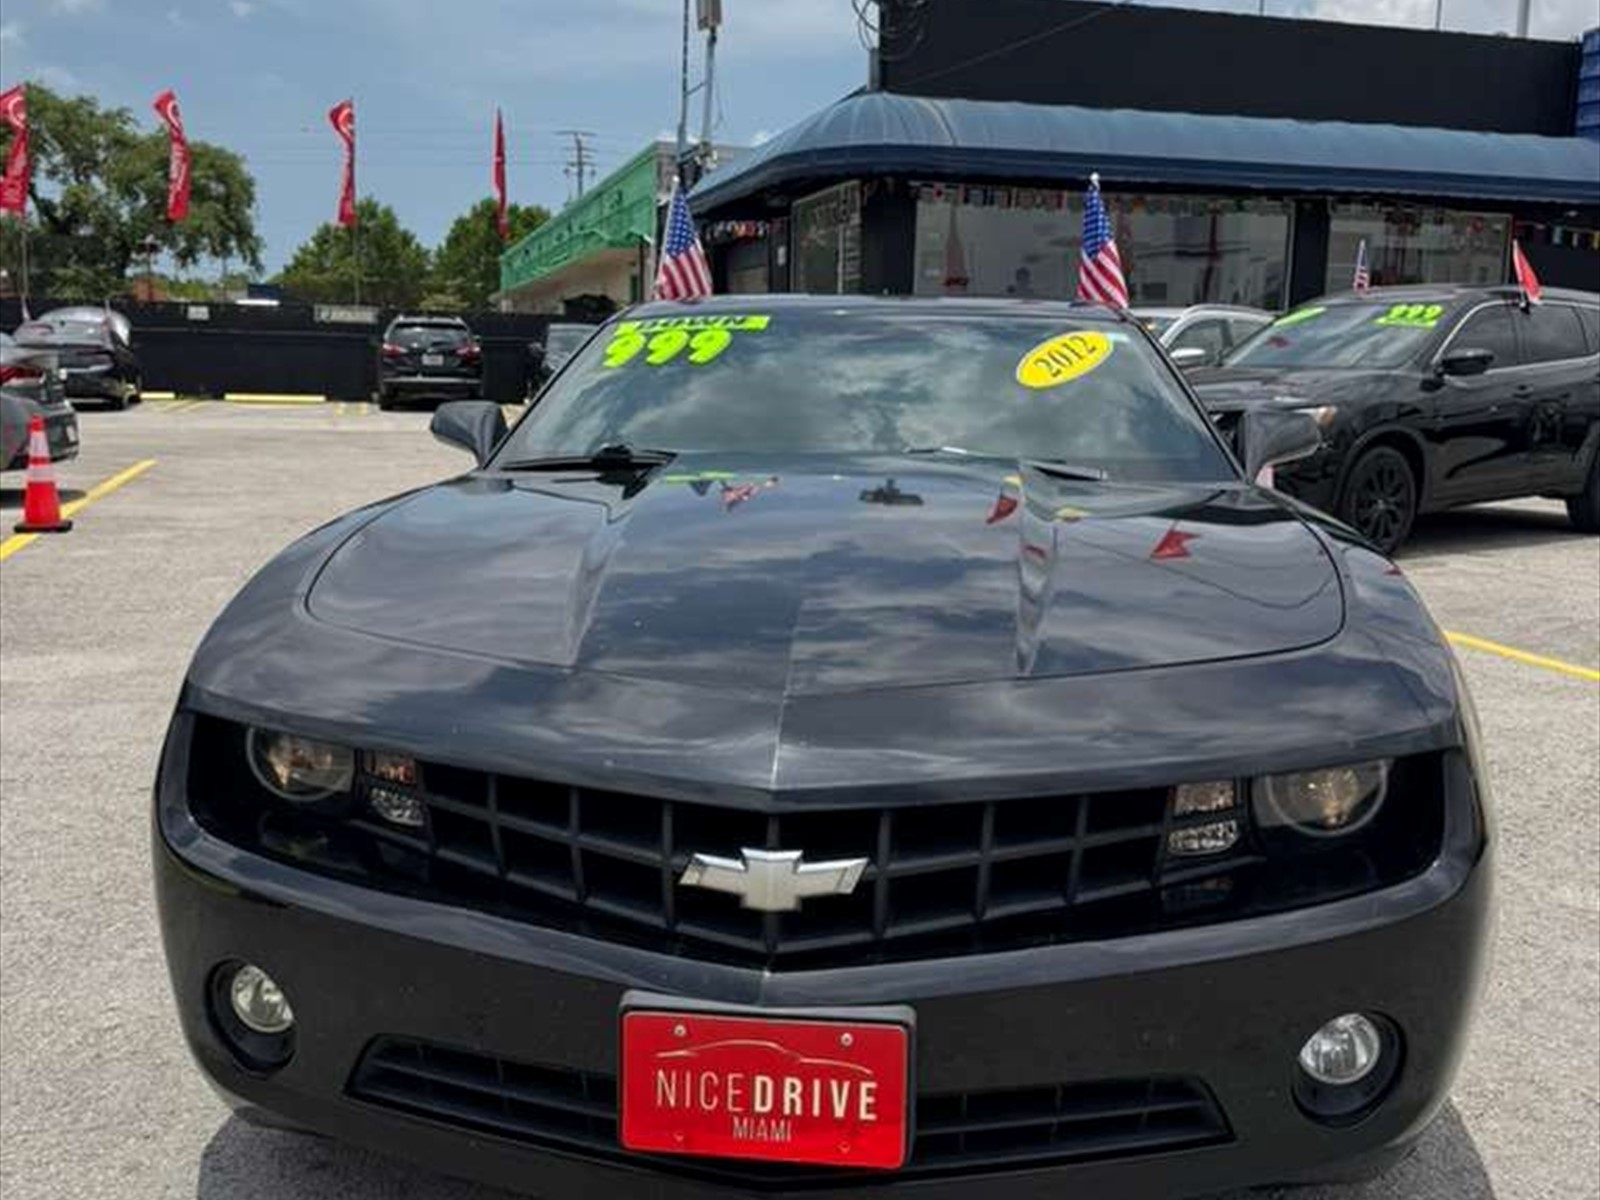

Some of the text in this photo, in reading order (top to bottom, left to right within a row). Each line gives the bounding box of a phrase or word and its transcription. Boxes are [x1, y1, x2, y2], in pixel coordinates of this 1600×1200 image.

[602, 329, 733, 368] 999
[1033, 335, 1097, 378] 2012
[732, 1116, 792, 1143] MIAMI
